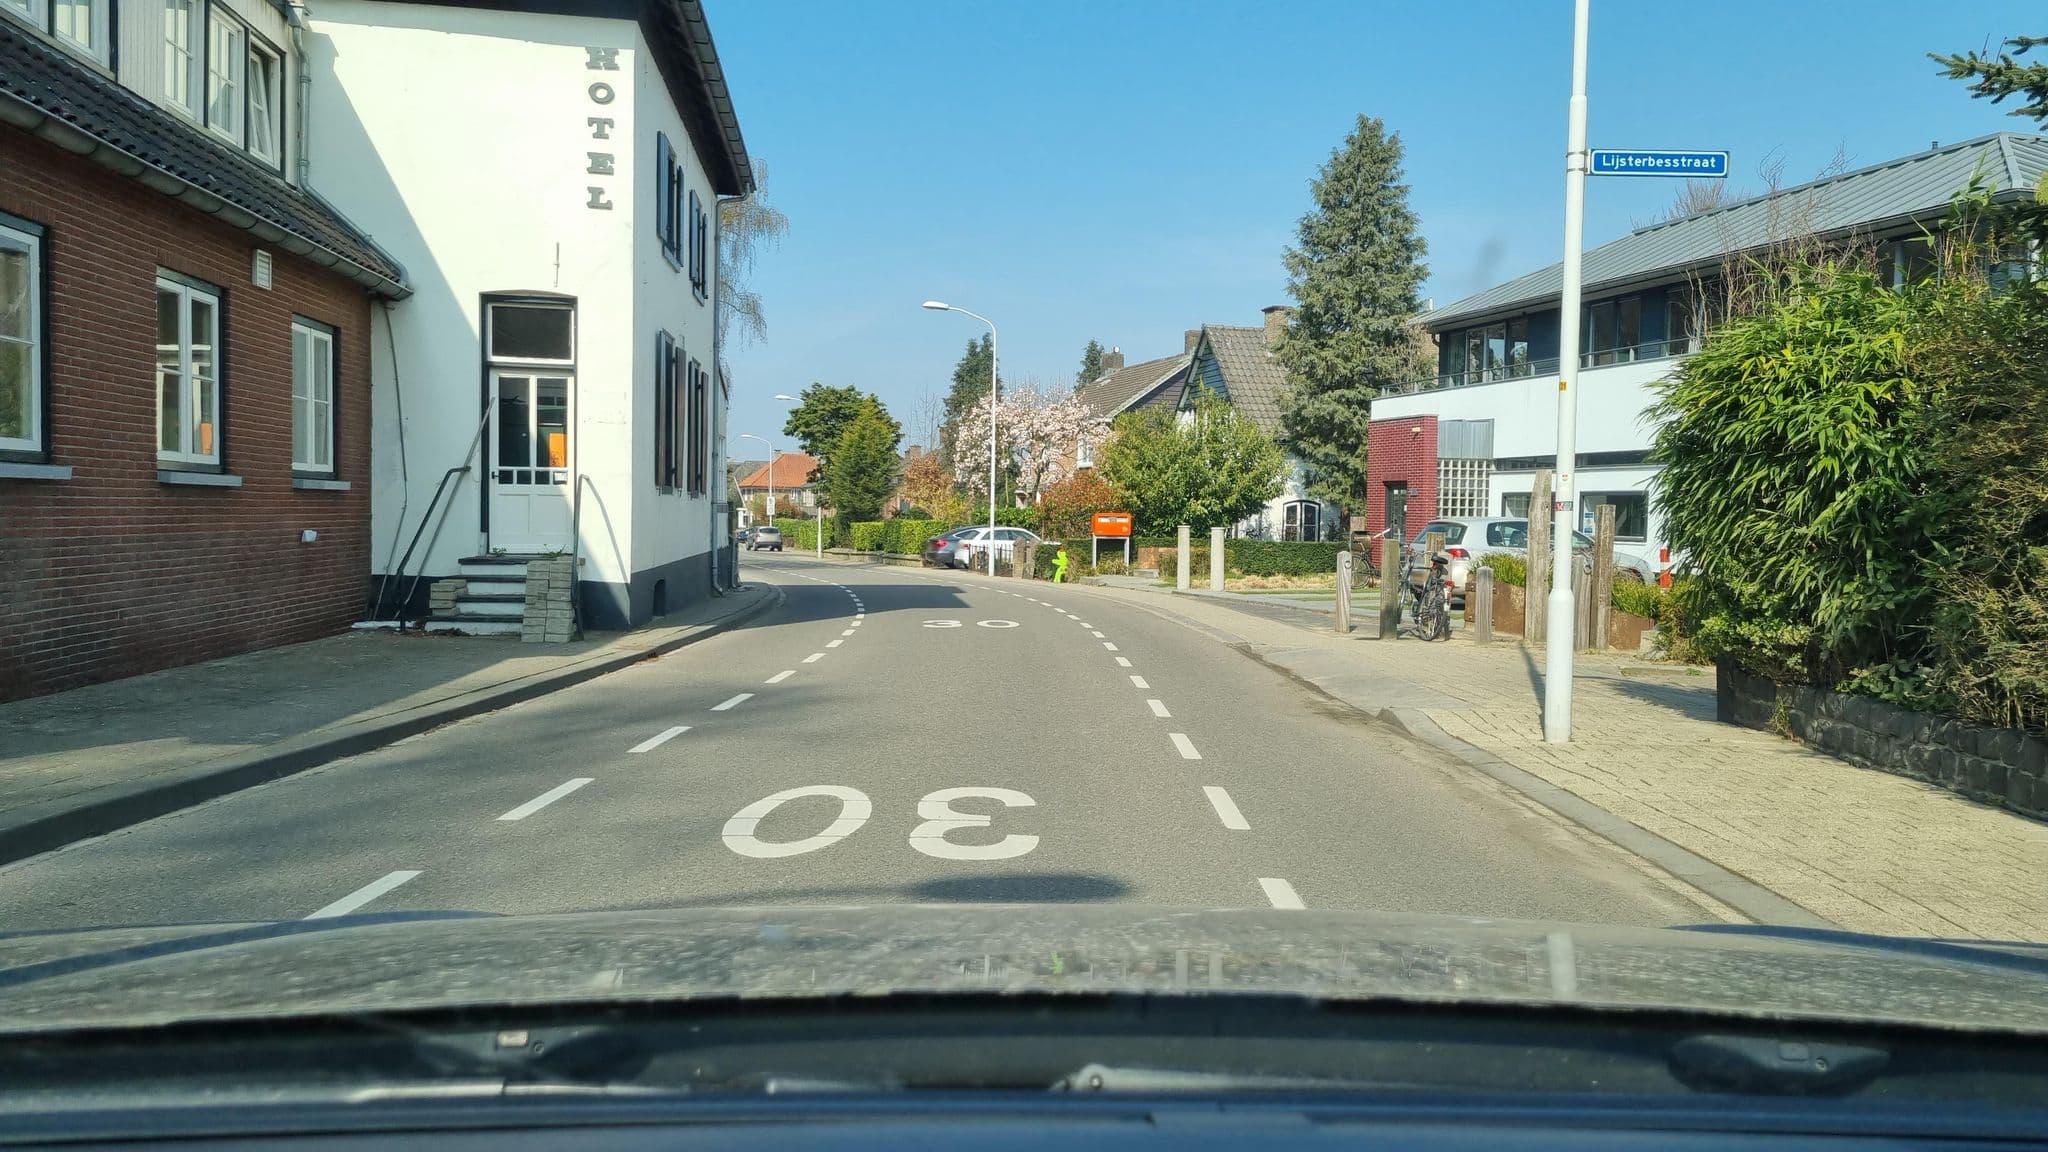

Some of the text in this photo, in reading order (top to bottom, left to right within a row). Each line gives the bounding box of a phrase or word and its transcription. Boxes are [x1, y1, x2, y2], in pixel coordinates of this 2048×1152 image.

[585, 46, 620, 210] HOTEL
[1602, 154, 1716, 170] Lijsterbesstraat
[922, 619, 1020, 628] 30
[721, 784, 1039, 860] 30
